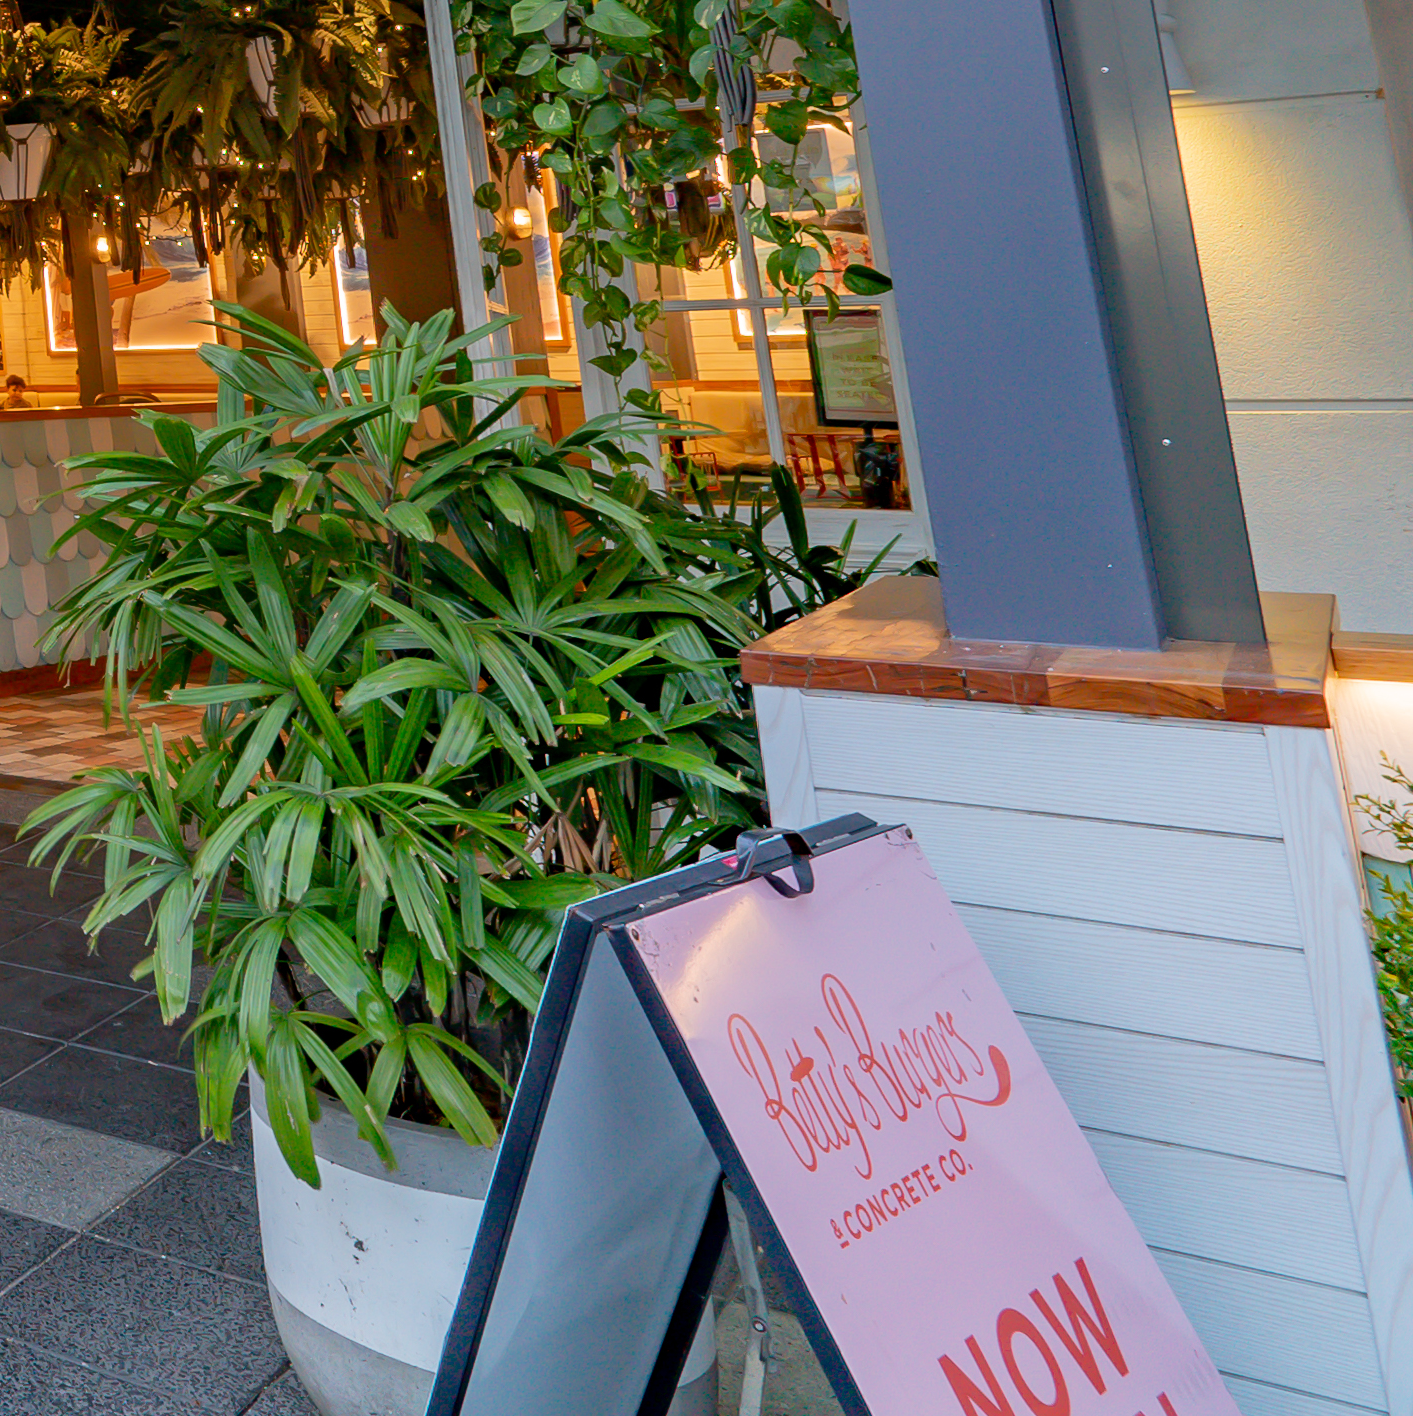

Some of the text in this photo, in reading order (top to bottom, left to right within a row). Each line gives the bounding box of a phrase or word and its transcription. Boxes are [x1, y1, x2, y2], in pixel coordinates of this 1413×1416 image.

[726, 972, 1012, 1181] Betty's Burgers
[938, 1148, 974, 1182] CO.
[936, 1257, 1130, 1416] NOW
